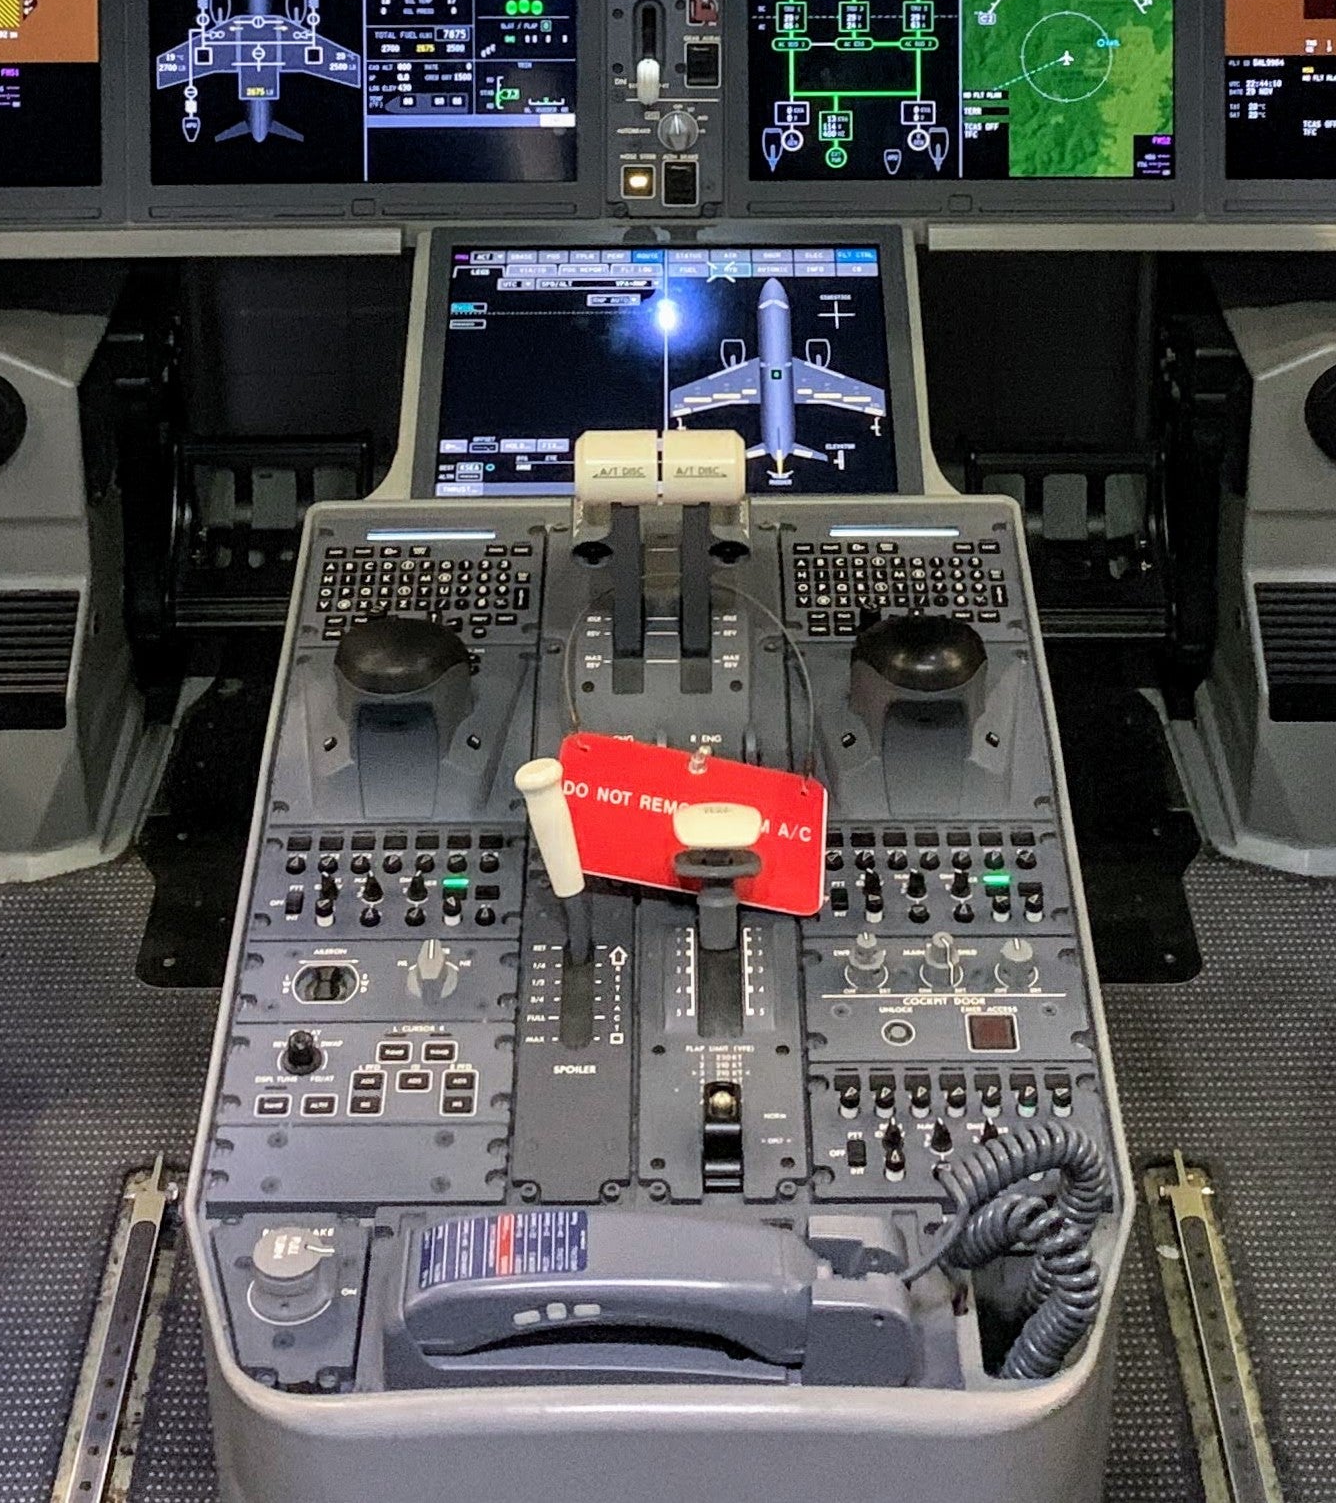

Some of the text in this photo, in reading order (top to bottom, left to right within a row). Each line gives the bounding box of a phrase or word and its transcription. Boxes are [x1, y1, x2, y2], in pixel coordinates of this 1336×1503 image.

[600, 467, 644, 476] A/T DISC
[676, 467, 719, 476] A/T DISC
[701, 734, 722, 743] ENG
[563, 780, 589, 798] DO
[597, 785, 633, 806] NOT
[639, 794, 691, 816] REM
[777, 821, 812, 842] A/C
[903, 996, 986, 1006] COCKPIT DOOR
[553, 1064, 596, 1075] SPOILER
